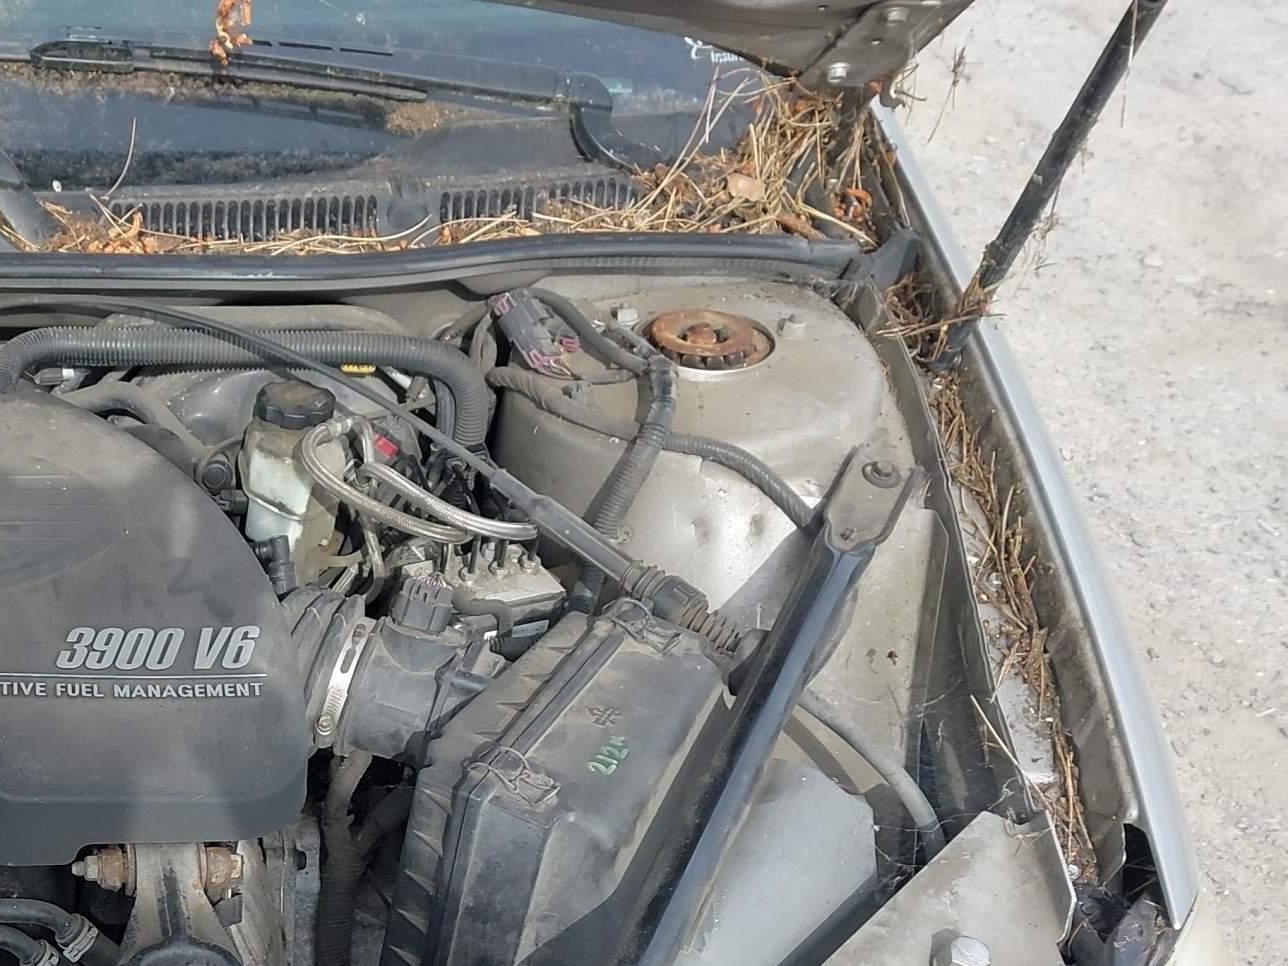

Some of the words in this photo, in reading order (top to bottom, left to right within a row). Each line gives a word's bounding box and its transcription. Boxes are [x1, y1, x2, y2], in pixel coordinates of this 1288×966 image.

[55, 626, 185, 670] 3900
[193, 625, 261, 670] V6
[55, 683, 104, 697] FUEL
[113, 683, 263, 698] MANAGEMENT
